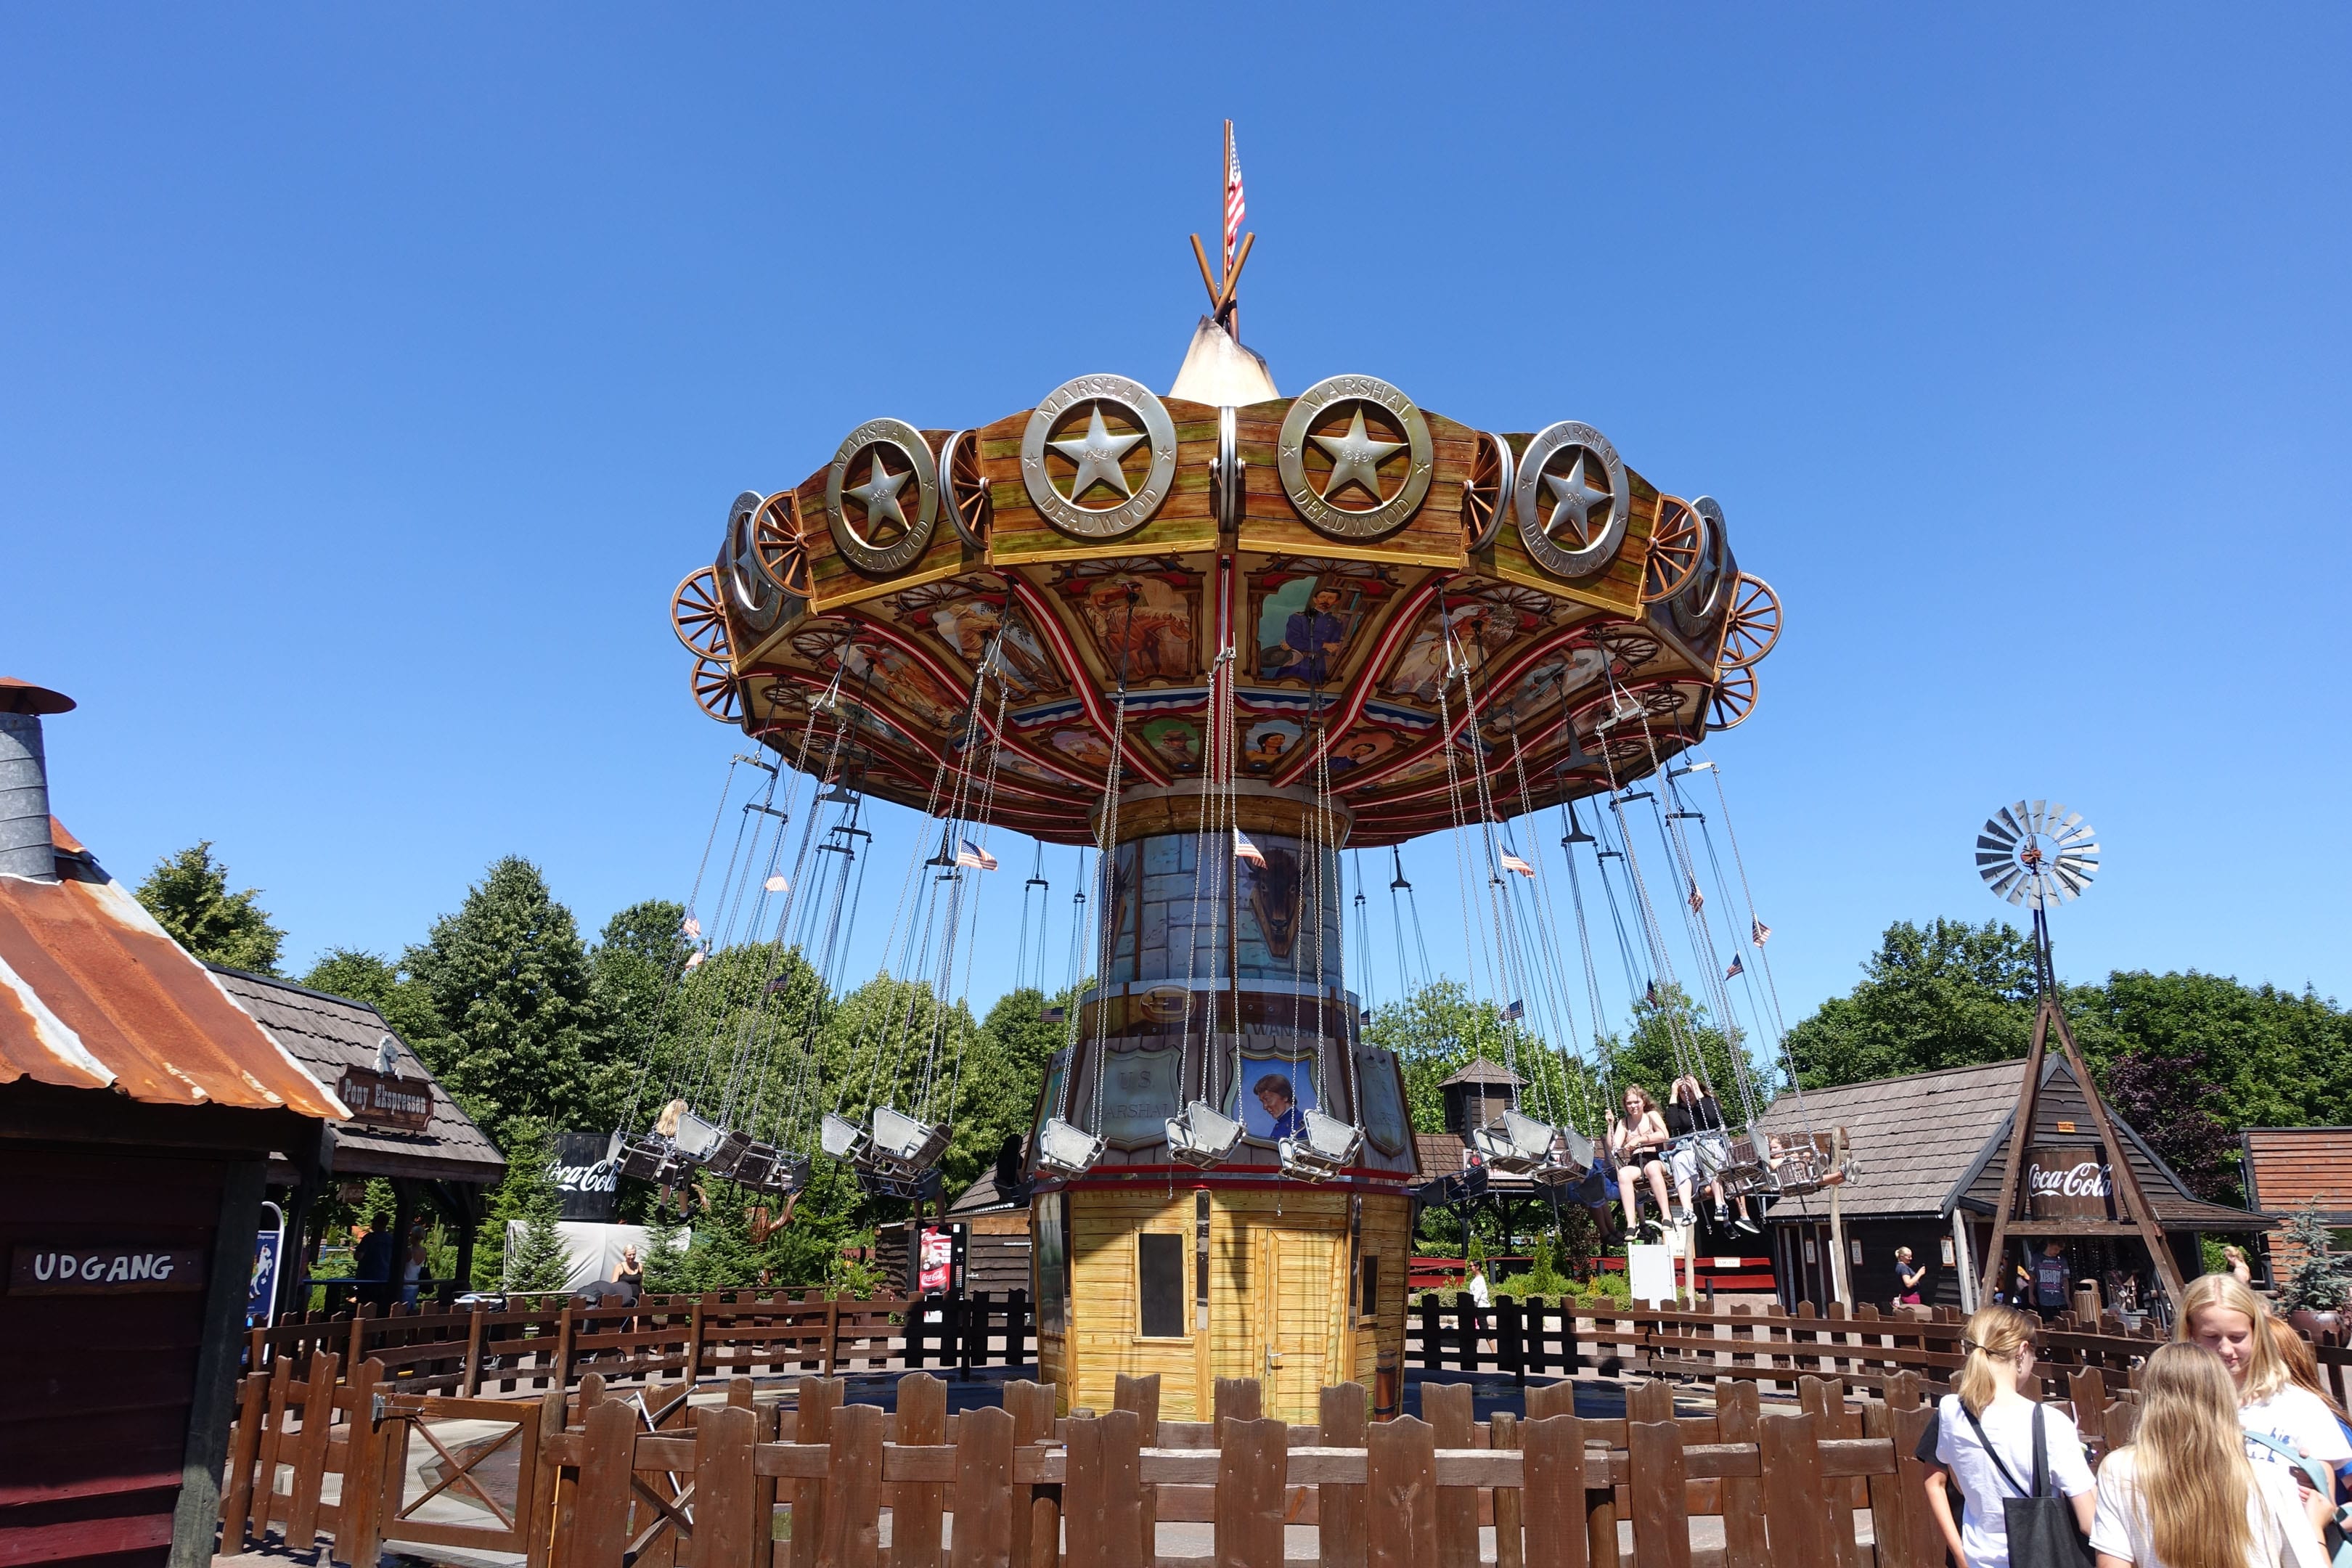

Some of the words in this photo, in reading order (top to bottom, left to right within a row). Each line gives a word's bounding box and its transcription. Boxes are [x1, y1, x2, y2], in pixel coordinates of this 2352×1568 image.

[1039, 377, 1147, 422] MARSHAL
[1302, 377, 1411, 422] MARSHAL
[834, 422, 910, 472] MARSHAL
[1541, 424, 1621, 475] MARSHAL
[1039, 489, 1159, 534] DEADWOOD
[1291, 486, 1412, 535] DEADWOOD
[843, 519, 929, 571] DEADWOOD
[1524, 519, 1609, 574] DEADWOOD
[343, 1077, 369, 1111] Pony
[374, 1083, 426, 1115] Ekspressen
[2028, 1161, 2113, 1198] Coca-Cola
[35, 1252, 174, 1282] UDGANG
